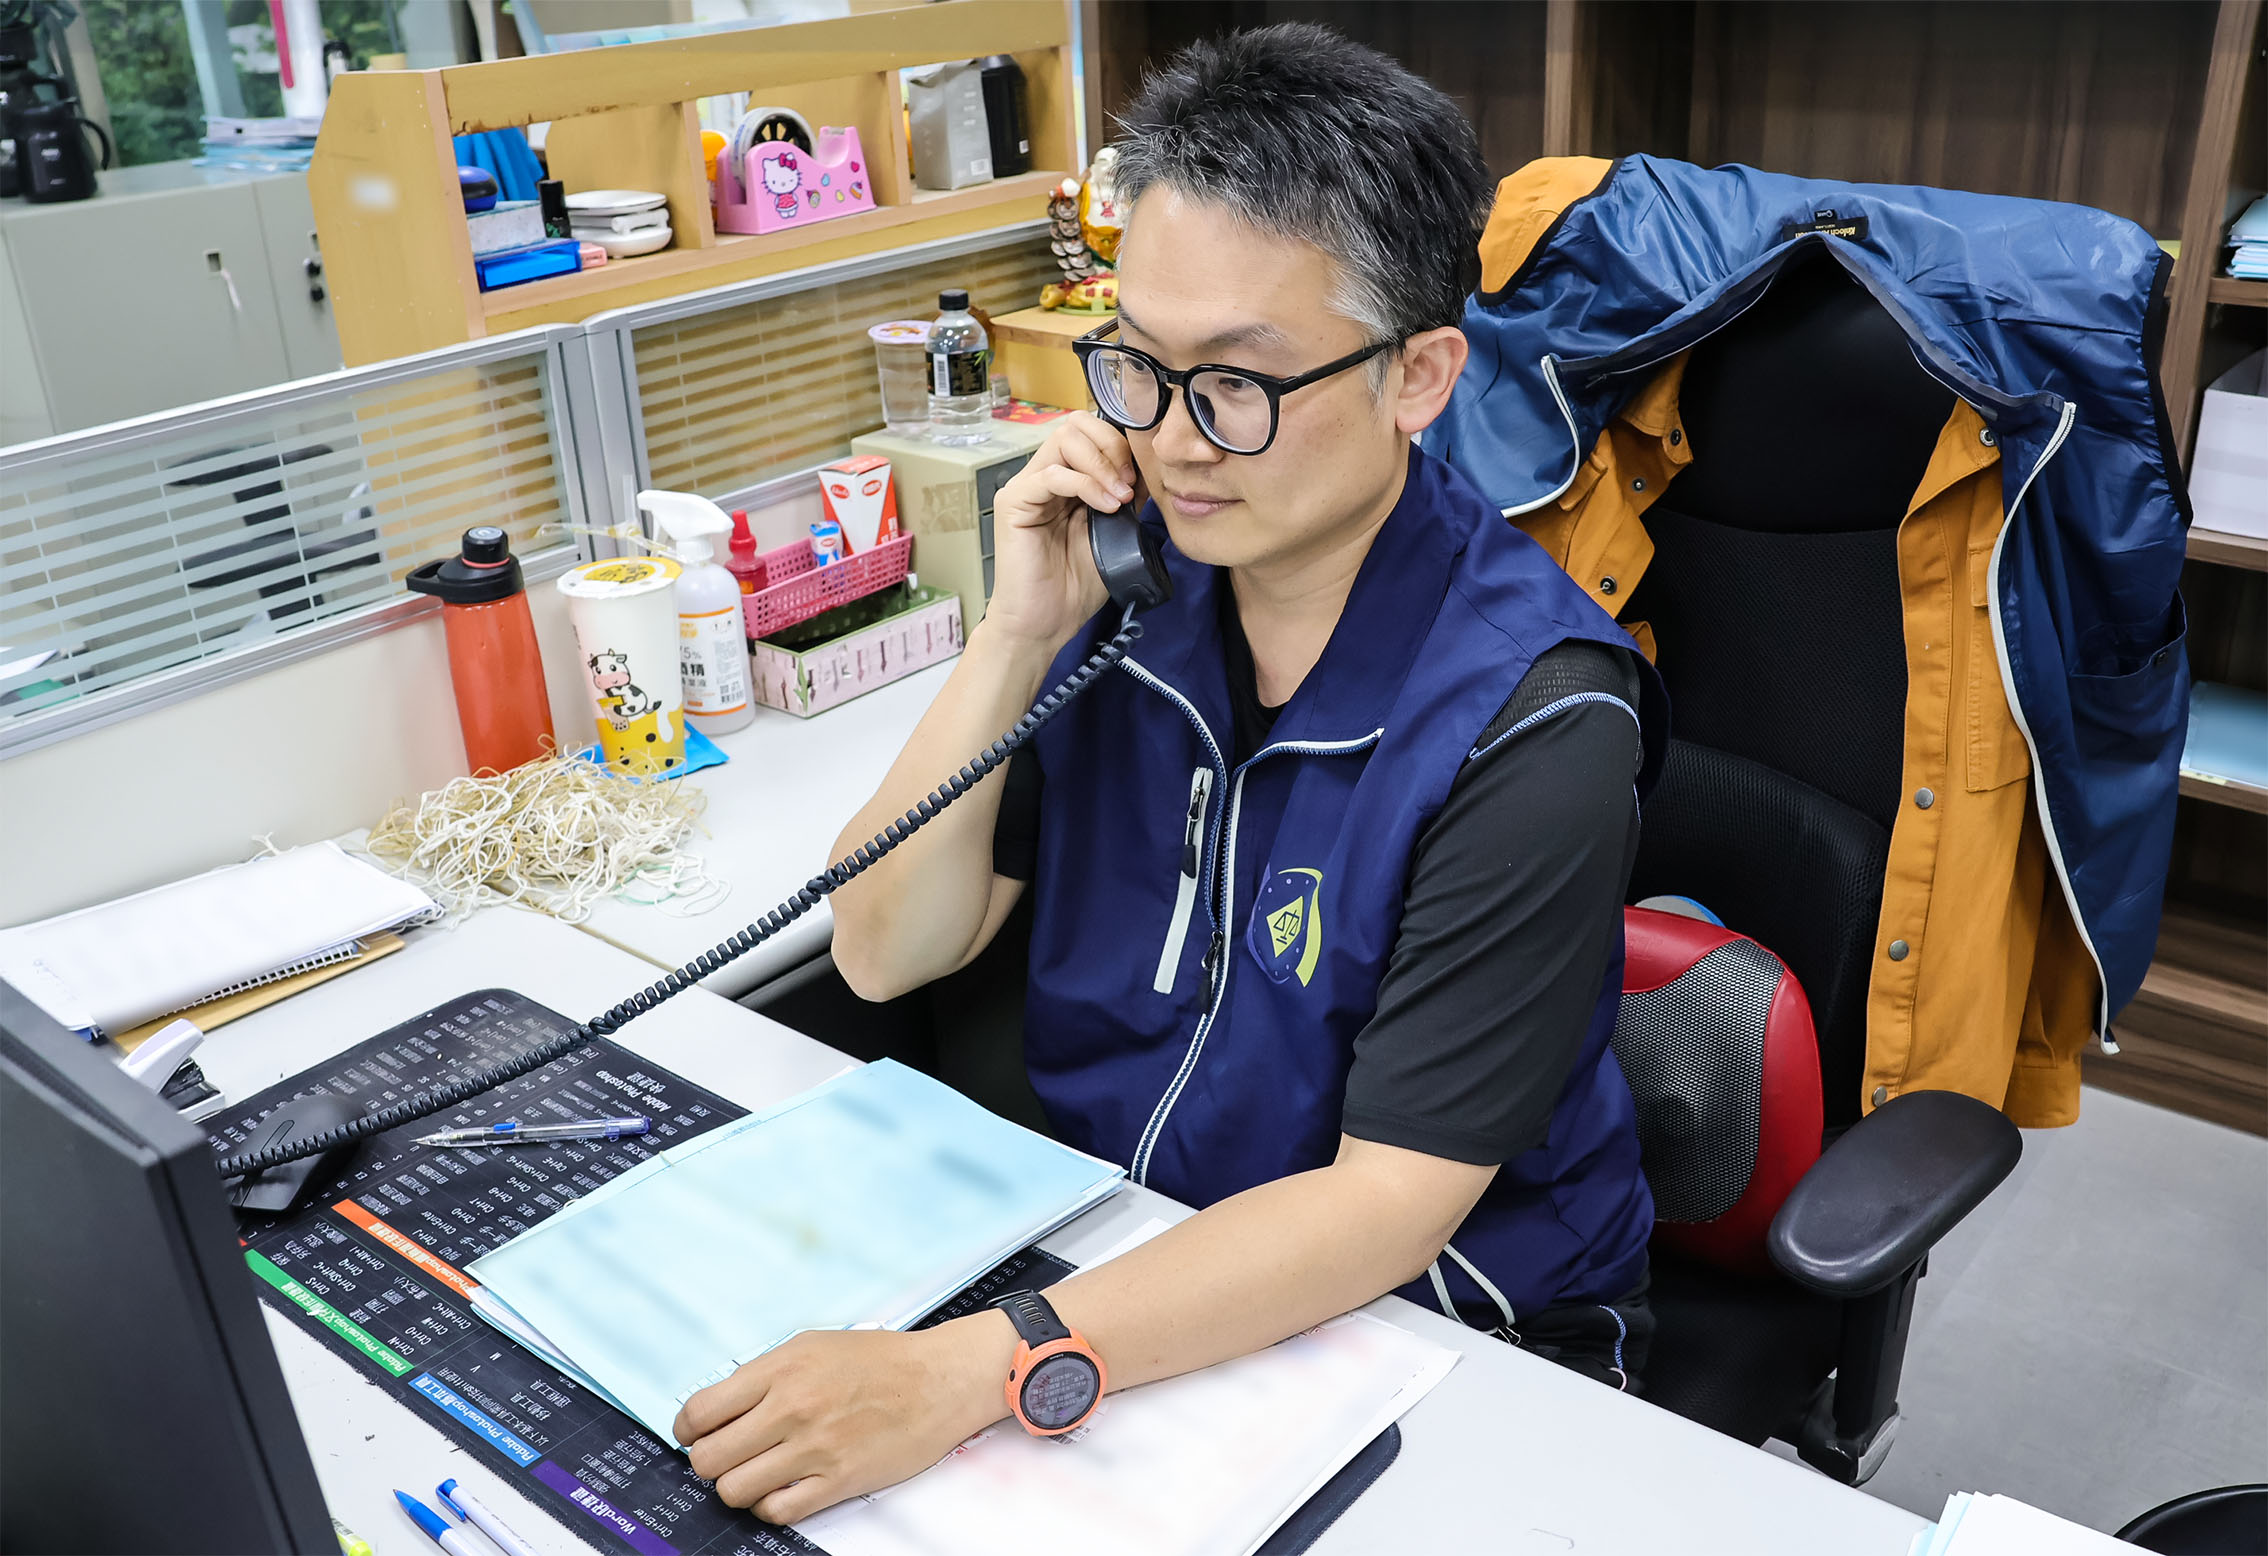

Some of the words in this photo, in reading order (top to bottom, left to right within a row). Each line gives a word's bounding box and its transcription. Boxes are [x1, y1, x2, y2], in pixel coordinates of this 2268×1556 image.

[1830, 226, 1856, 237] Kinloch
[595, 1070, 642, 1097] Photoshop
[626, 1071, 665, 1099] 快捷鍵
[641, 1094, 671, 1112] Adobe
[371, 1161, 385, 1170] PO
[505, 1155, 549, 1181] Ctrl+Shift+G
[542, 1156, 567, 1171] Ctrl+E
[587, 1161, 617, 1180] 背景色
[354, 1171, 367, 1180] EX
[506, 1176, 531, 1192] Ctrl+G
[569, 1170, 600, 1191] 前景色
[488, 1187, 512, 1202] Ctrl+B
[468, 1197, 494, 1212] Ctrl+T
[420, 1210, 456, 1234] Ctrl+Enter
[451, 1207, 475, 1223] Ctrl+D
[302, 1233, 323, 1248] 退出
[412, 1229, 437, 1245] Ctrl+J
[270, 1252, 290, 1265] 保存
[337, 1257, 363, 1275] Ctrl+Q
[349, 1245, 384, 1270] Ctrl+Alt+I
[305, 1276, 330, 1294] Ctrl+S
[312, 1261, 356, 1291] Ctrl+Shift+C
[393, 1276, 428, 1299] 畫布大小
[364, 1298, 389, 1314] 打開
[348, 1308, 371, 1323] 新建
[431, 1302, 471, 1329] Ctrl+Alt+C
[420, 1316, 448, 1335] Ctrl+W
[404, 1326, 431, 1345] Ctrl+O
[387, 1336, 414, 1355] Ctrl+N
[377, 1350, 406, 1371] Adobe
[489, 1351, 501, 1360] M
[469, 1364, 480, 1372] V
[529, 1378, 571, 1408] 選框工具
[415, 1376, 503, 1438] Photoshop基本工具
[509, 1391, 551, 1420] 移動工具
[501, 1436, 534, 1460] Adobe
[613, 1439, 651, 1465] 1.5倍行距
[679, 1483, 706, 1501] Ctrl+5
[569, 1486, 636, 1534] Word快捷鍵
[666, 1493, 692, 1511] Ctrl+1
[651, 1504, 679, 1521] Ctrl+F
[632, 1508, 672, 1537] Ctrl+Enter
